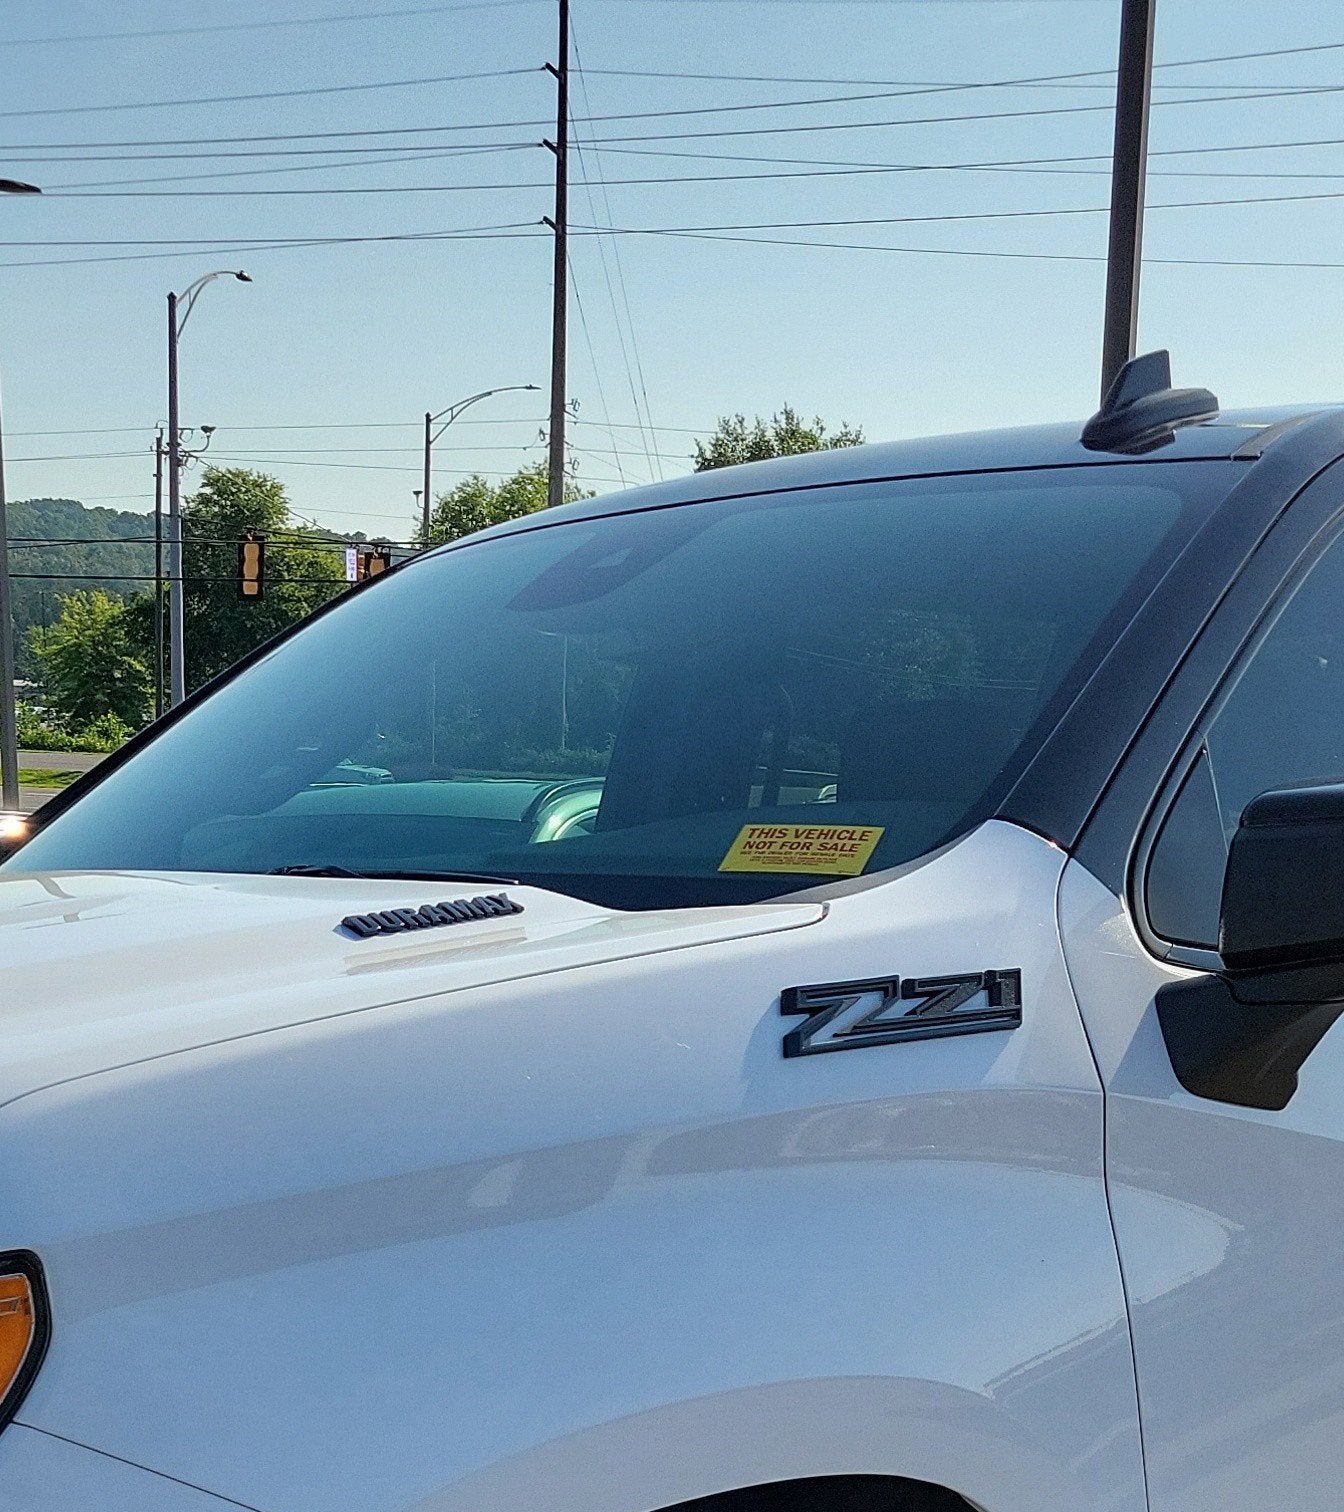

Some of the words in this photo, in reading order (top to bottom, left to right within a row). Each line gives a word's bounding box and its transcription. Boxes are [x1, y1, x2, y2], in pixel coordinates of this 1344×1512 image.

[742, 840, 777, 850] NOT
[779, 841, 812, 851] FOR
[816, 842, 862, 853] SALE
[747, 827, 790, 840] THIS
[793, 828, 874, 842] VEHICLE
[340, 892, 525, 938] DURAMAX
[779, 967, 1024, 1059] Z71
